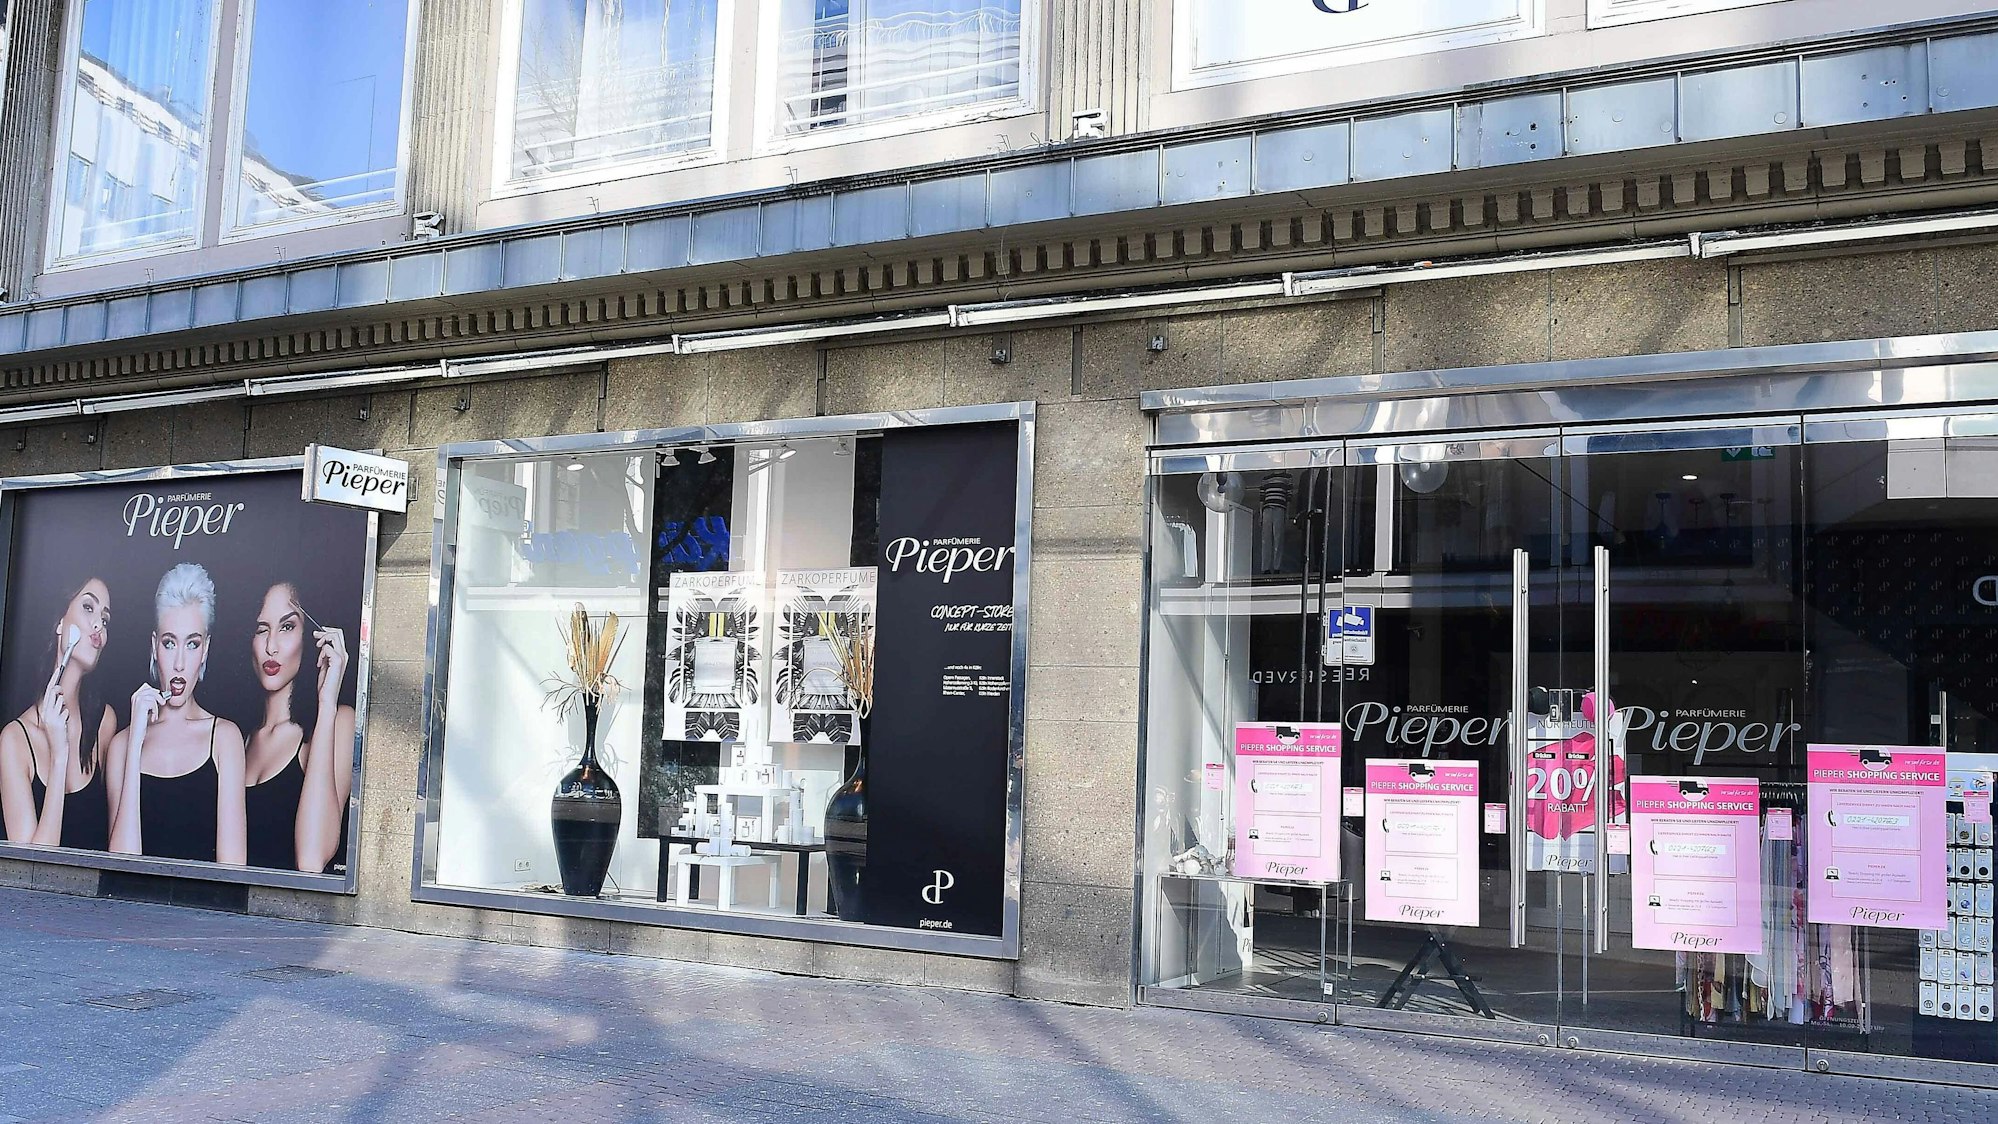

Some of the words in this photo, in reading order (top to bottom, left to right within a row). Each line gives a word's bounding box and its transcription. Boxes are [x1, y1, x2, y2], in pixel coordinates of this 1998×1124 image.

[323, 460, 405, 496] Pieper
[353, 464, 406, 480] PARFÜMERIE
[167, 492, 211, 502] PARFÜMERIE
[123, 493, 245, 549] Pieper
[933, 537, 981, 546] PARFÜMERIE
[885, 537, 1015, 583] Pieper
[781, 571, 876, 585] ZARKOPERFUME
[944, 623, 960, 632] NUR
[960, 621, 973, 631] FÜR
[974, 622, 996, 632] KURZE
[1406, 703, 1469, 713] PARFÜMERIE
[1675, 708, 1746, 718] PARFÜMERIE
[1344, 701, 1511, 758] Pieper
[1607, 706, 1801, 766] Pieper
[1240, 743, 1264, 751] PIEPER
[1266, 744, 1304, 752] SHOPPING
[1306, 745, 1337, 753] SERVICE
[1813, 769, 1845, 778] PIEPER
[1847, 770, 1898, 780] SHOPPING
[1900, 772, 1940, 781] SERVICE
[1371, 781, 1396, 790] PIEPER
[1399, 782, 1440, 791] SHOPPING
[1441, 784, 1474, 792] SERVICE
[1547, 802, 1588, 813] RABATT
[1636, 800, 1665, 809] PIEPER
[1667, 801, 1715, 810] SHOPPING
[1716, 802, 1754, 811] SERVICE
[1266, 861, 1308, 877] Pieper
[1545, 854, 1593, 870] Pieper
[1399, 904, 1445, 920] Pieper
[1849, 906, 1905, 923] Pieper
[919, 918, 953, 929] pieper.de
[1670, 931, 1723, 949] Pieper
